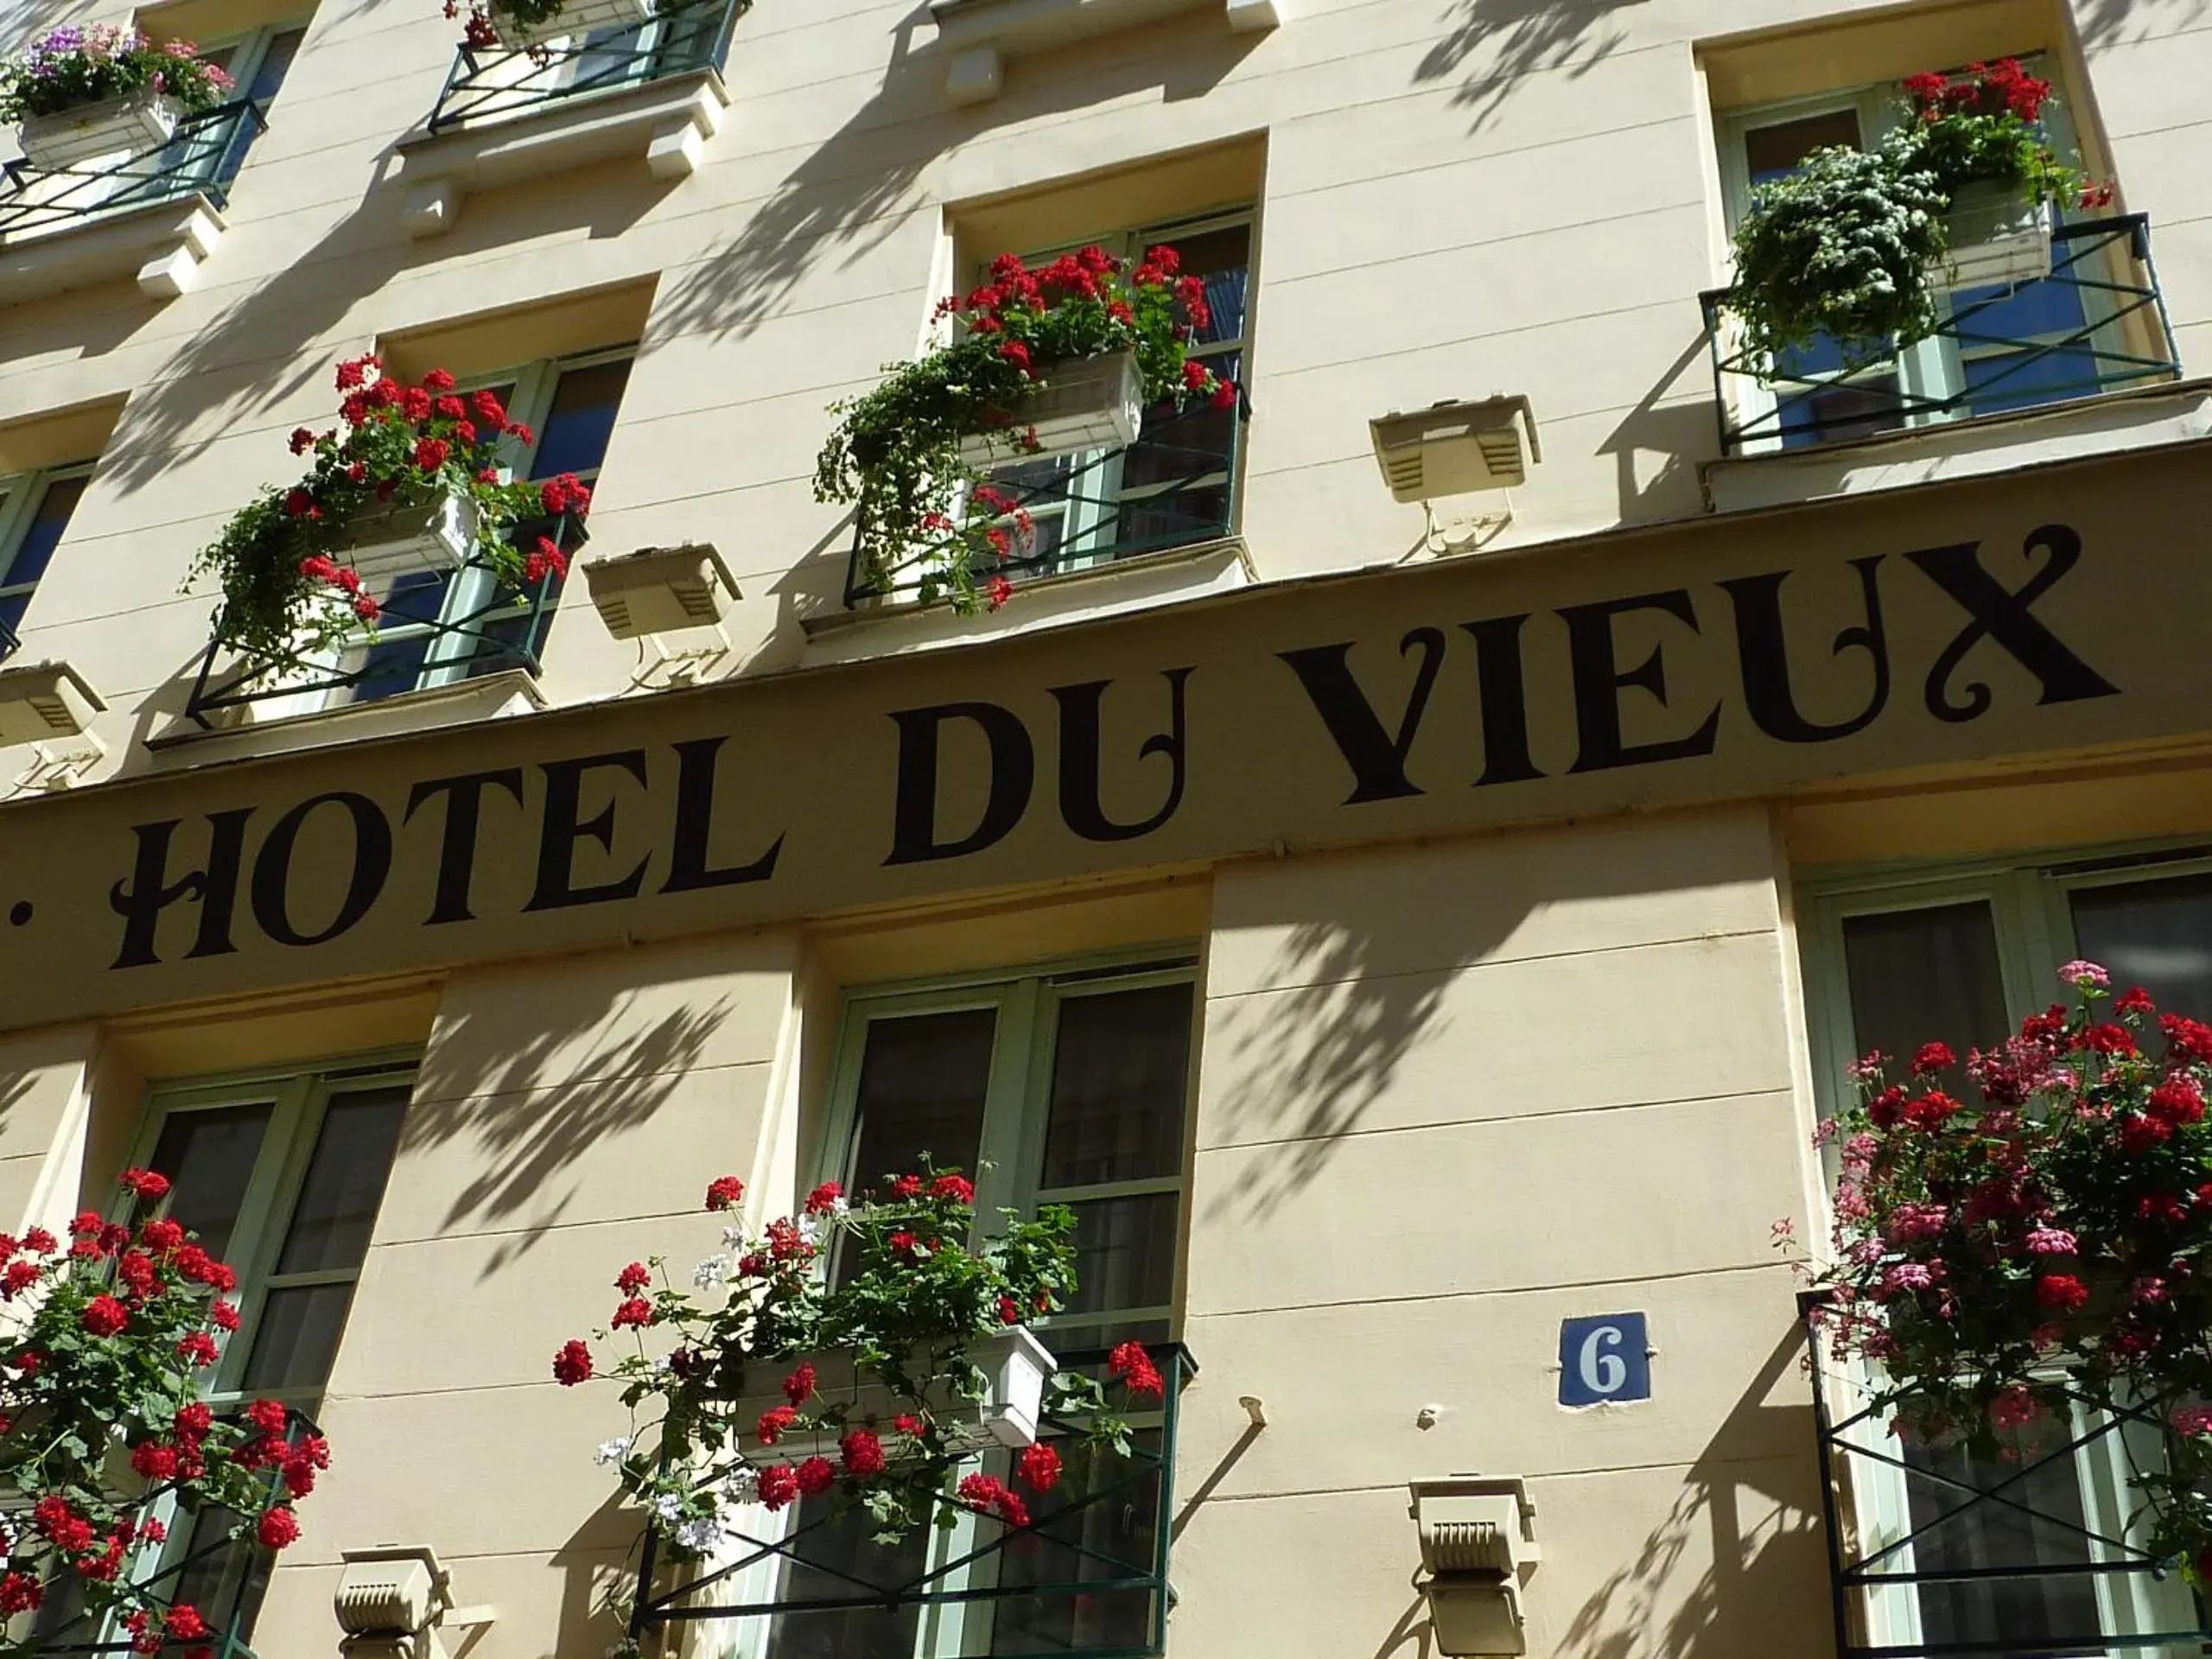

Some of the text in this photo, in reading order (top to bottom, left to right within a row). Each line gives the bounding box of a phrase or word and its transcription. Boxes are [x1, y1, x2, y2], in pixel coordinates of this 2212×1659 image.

[109, 523, 2123, 969] HOTEL DU VIEUX
[1580, 1325, 1626, 1393] 6
